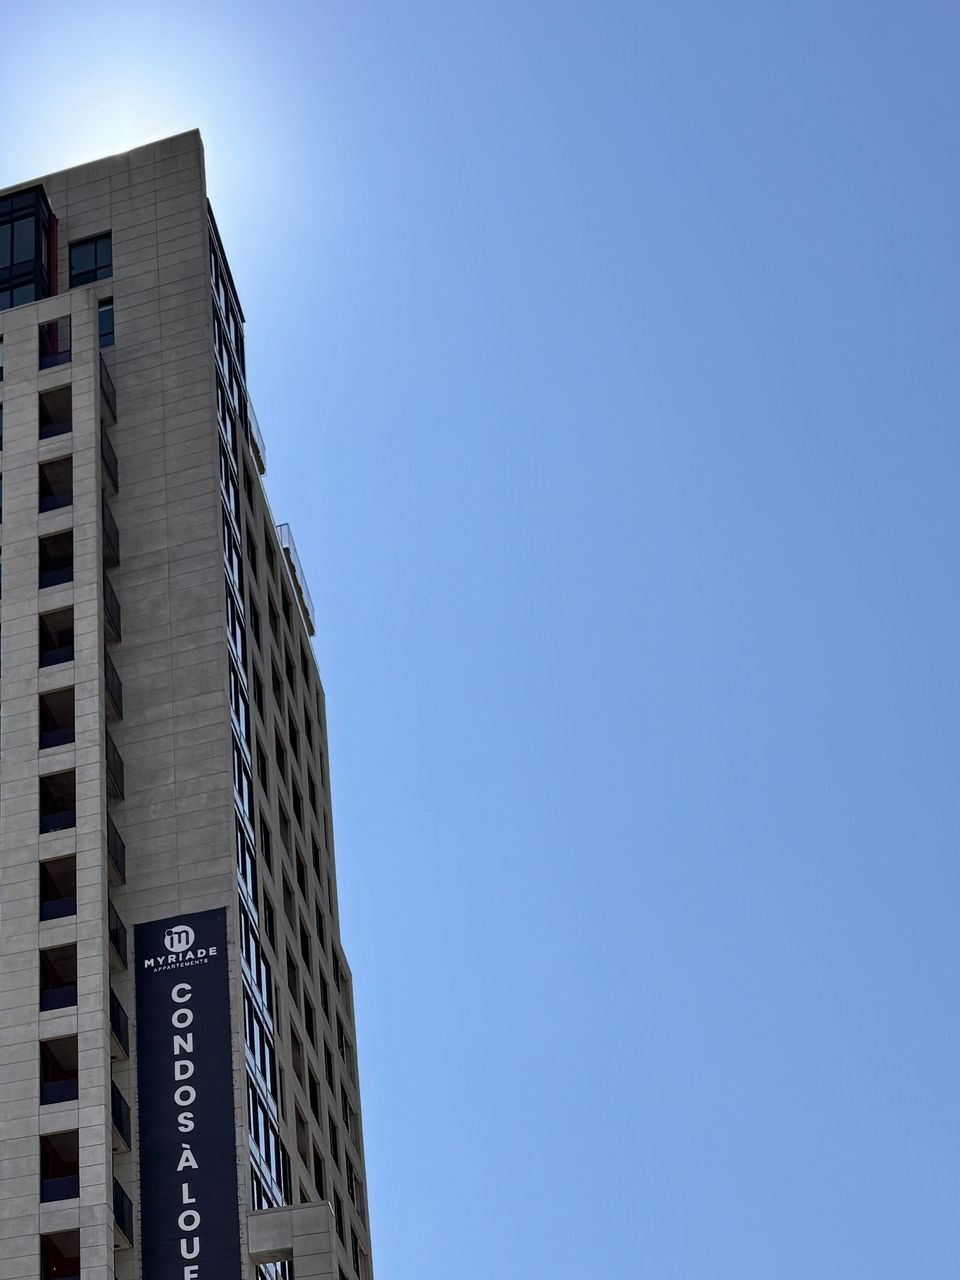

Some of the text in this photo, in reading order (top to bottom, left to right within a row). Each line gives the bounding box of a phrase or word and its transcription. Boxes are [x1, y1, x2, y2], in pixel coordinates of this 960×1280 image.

[144, 947, 218, 969] MYRIADE
[153, 959, 208, 972] APPARTEMENTS
[171, 982, 196, 1133] CONDOS
[176, 1143, 198, 1172] À
